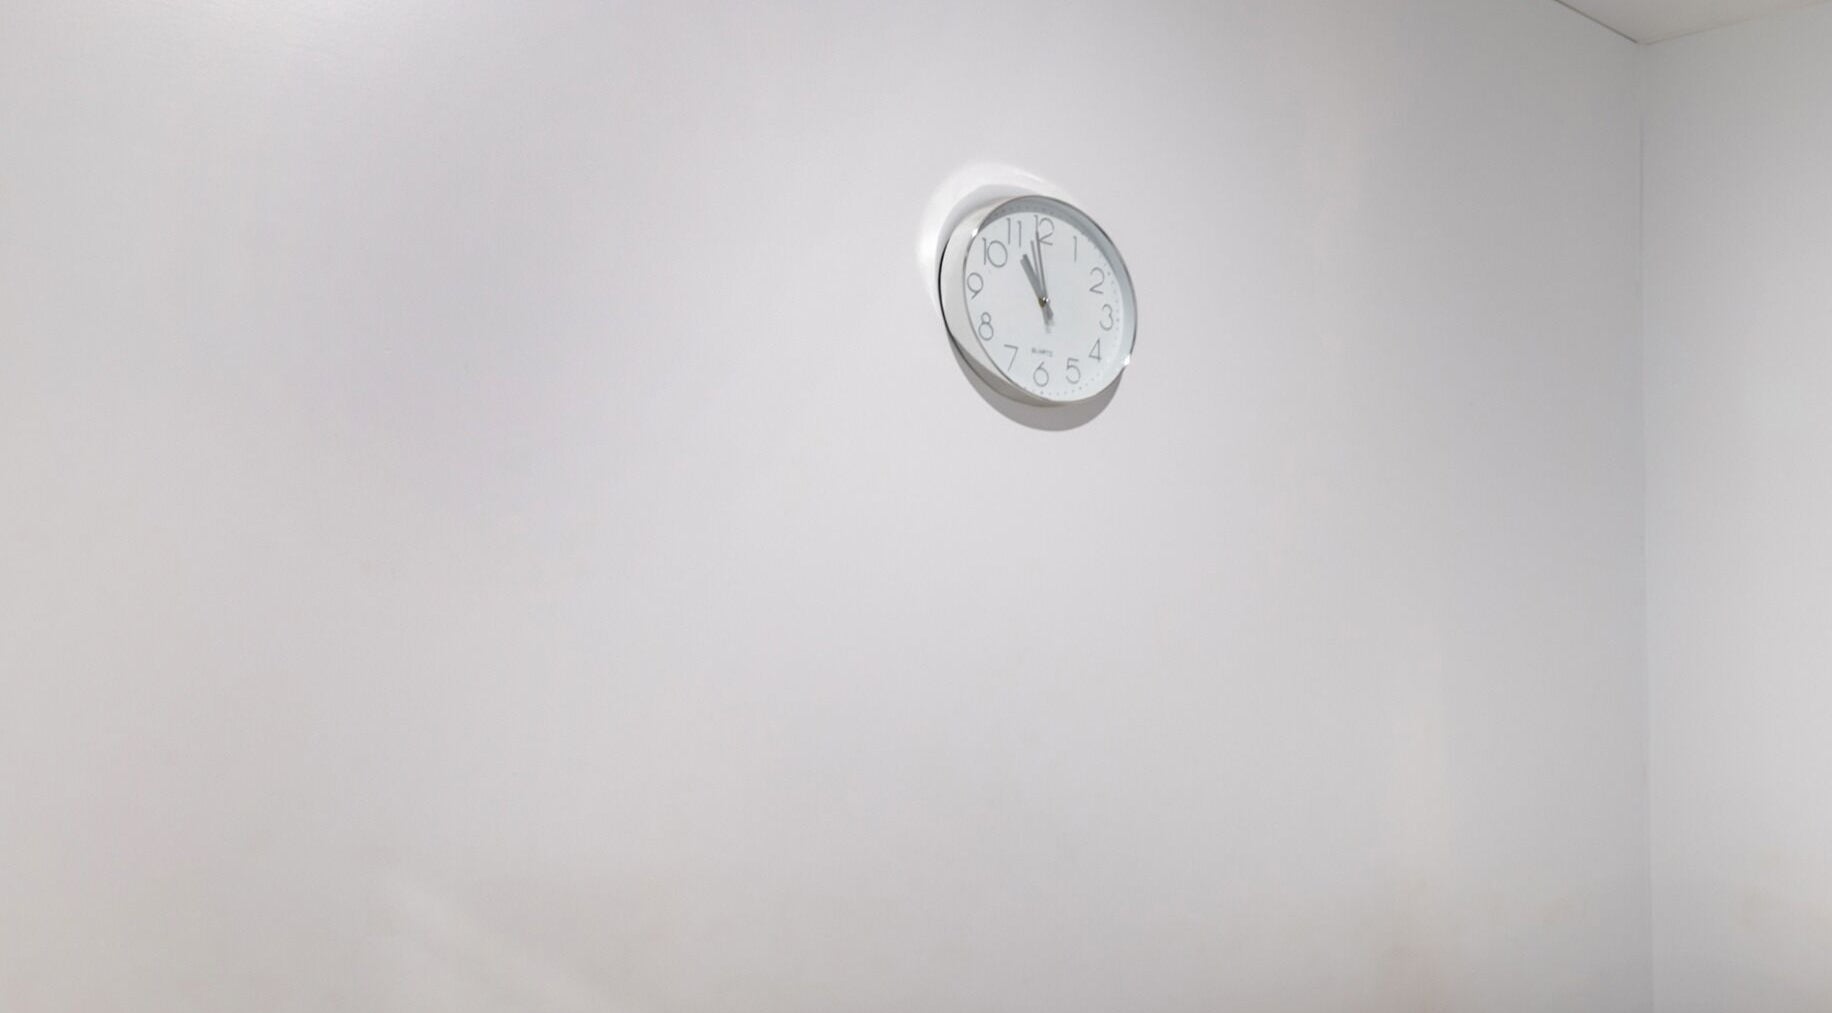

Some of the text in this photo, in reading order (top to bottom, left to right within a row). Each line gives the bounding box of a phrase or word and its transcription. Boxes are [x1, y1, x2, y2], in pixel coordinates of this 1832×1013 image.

[1006, 217, 1022, 248] 11
[1034, 215, 1055, 246] 12
[981, 237, 1008, 268] 10
[1072, 235, 1078, 263] 1
[967, 272, 984, 300] 9
[1089, 267, 1105, 294] 2
[978, 312, 994, 341] 8
[1099, 304, 1114, 331] 3
[1003, 344, 1019, 371] 7
[1088, 338, 1103, 363] 4
[1033, 361, 1049, 387] 6
[1065, 357, 1081, 384] 5
